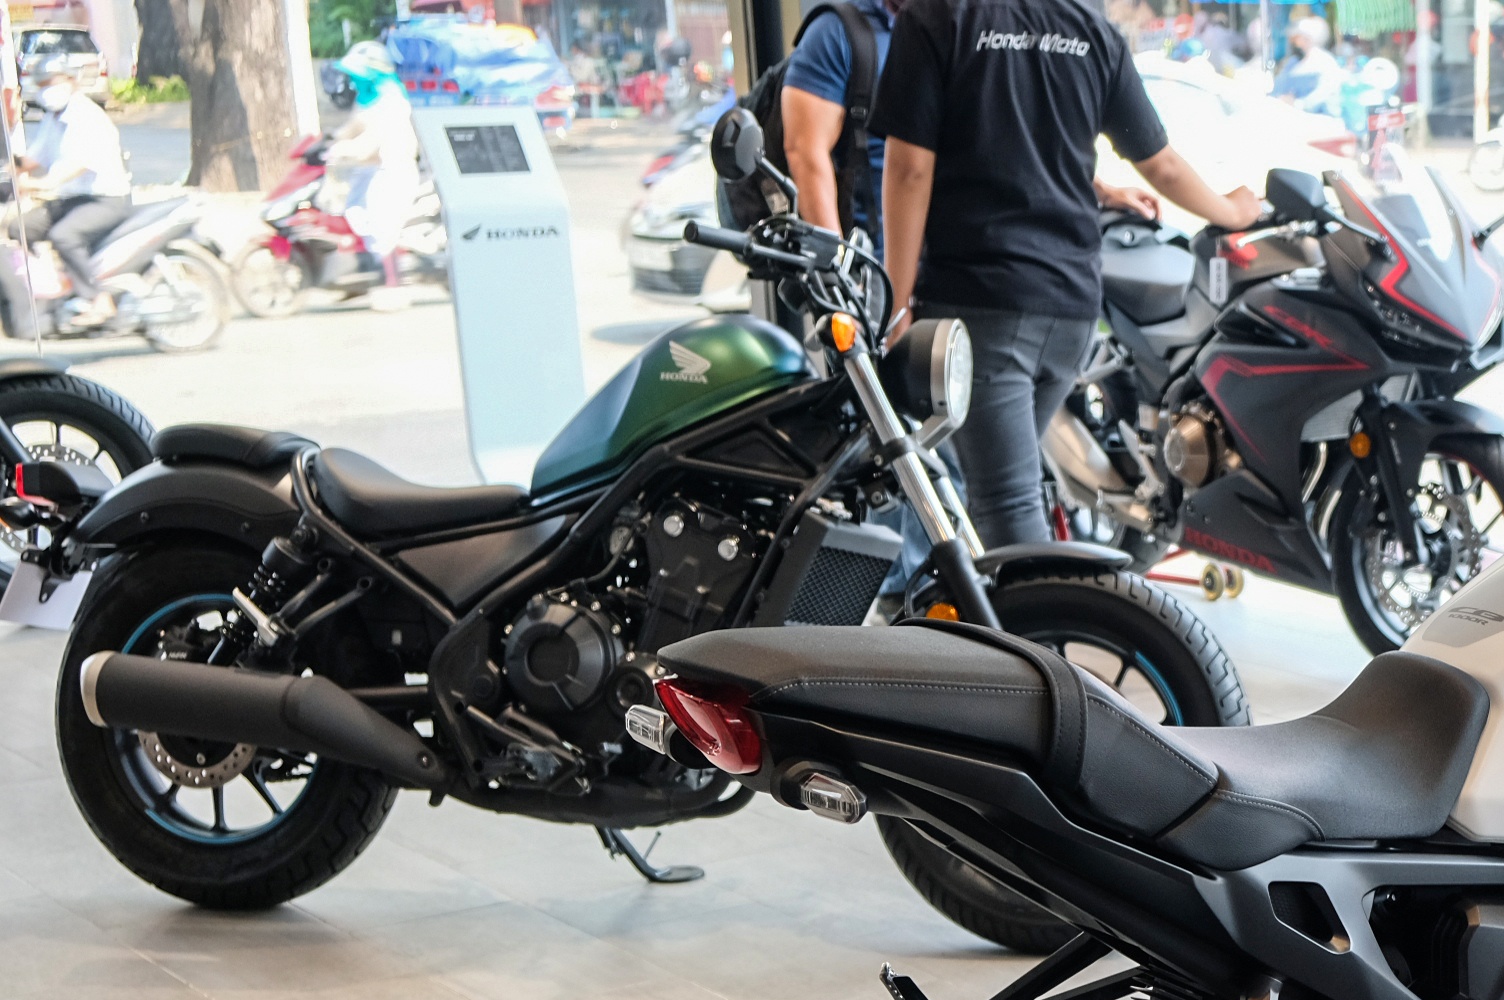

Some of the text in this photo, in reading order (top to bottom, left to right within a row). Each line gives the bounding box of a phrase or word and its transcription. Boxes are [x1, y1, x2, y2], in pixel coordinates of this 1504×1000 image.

[976, 29, 1091, 57] Honda Moto
[486, 225, 559, 240] HONDA
[660, 371, 709, 385] HONDA
[1184, 526, 1278, 575] HONDA
